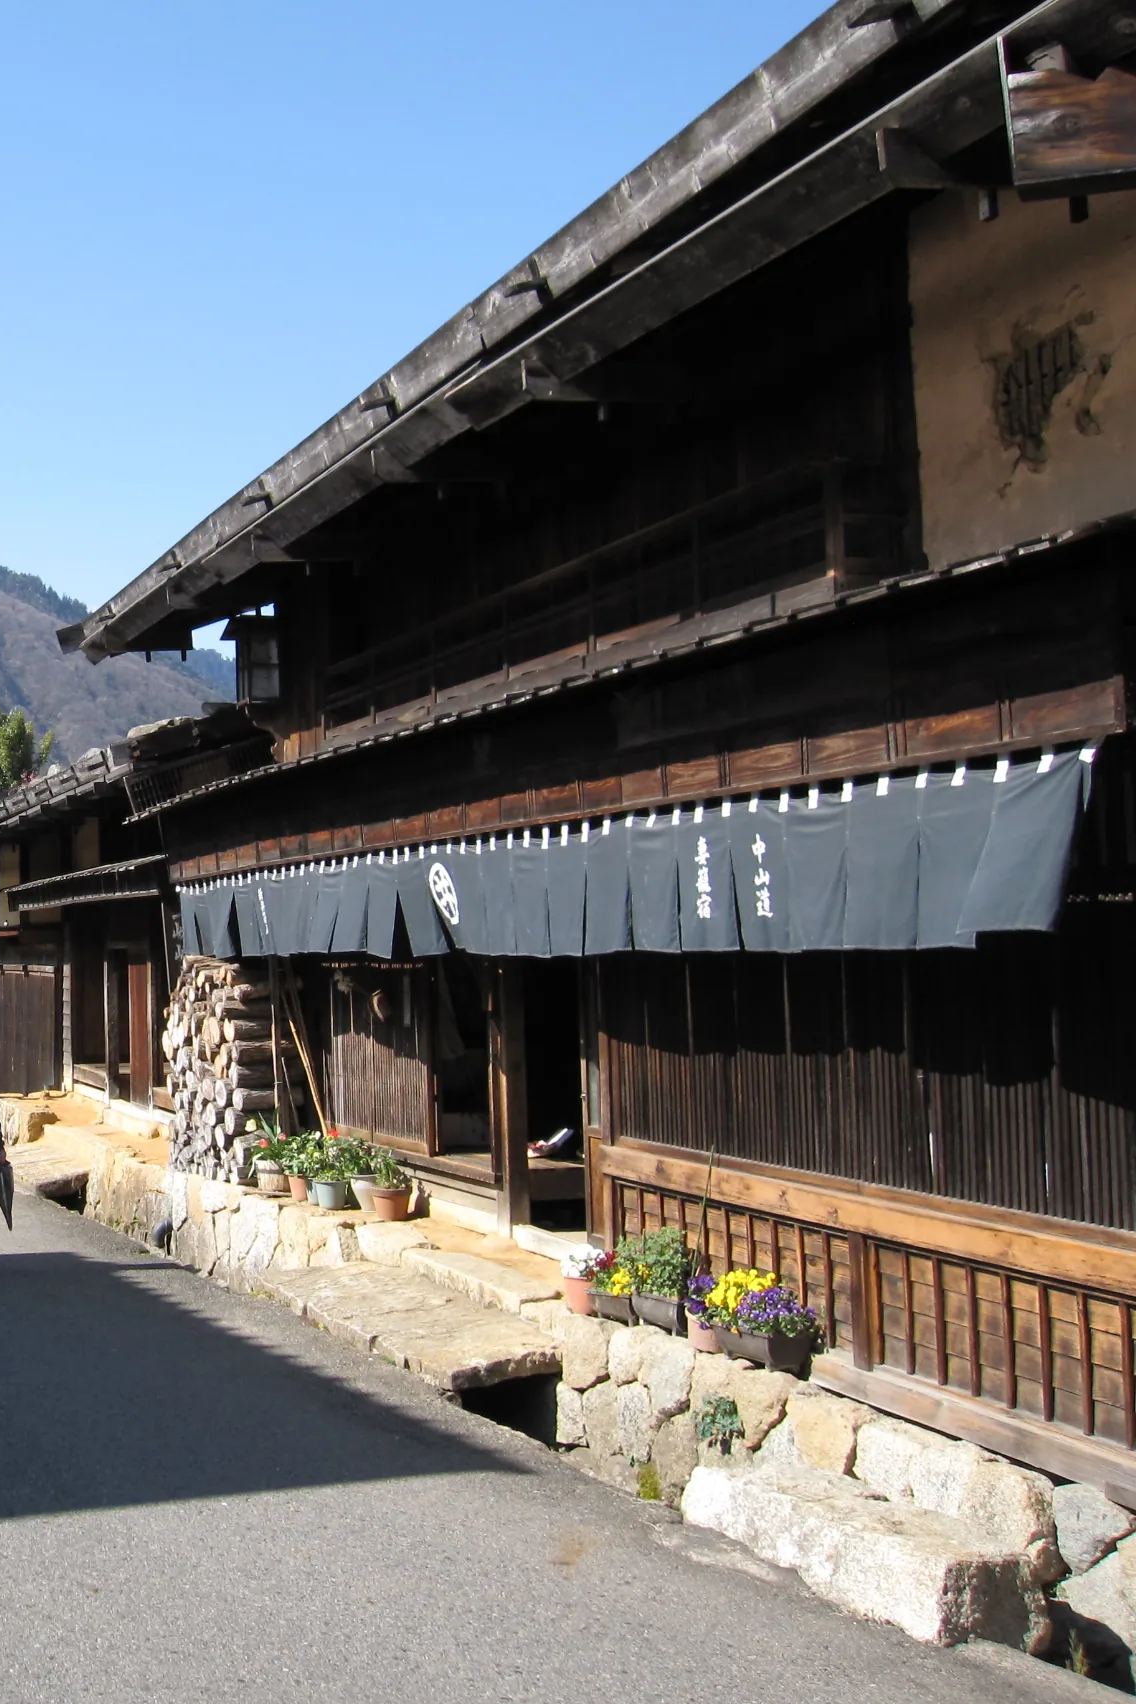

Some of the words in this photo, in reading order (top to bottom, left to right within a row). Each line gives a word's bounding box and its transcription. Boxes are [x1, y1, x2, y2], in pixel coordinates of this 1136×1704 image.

[694, 835, 712, 919] 妻籠宿
[752, 833, 773, 918] 中山道
